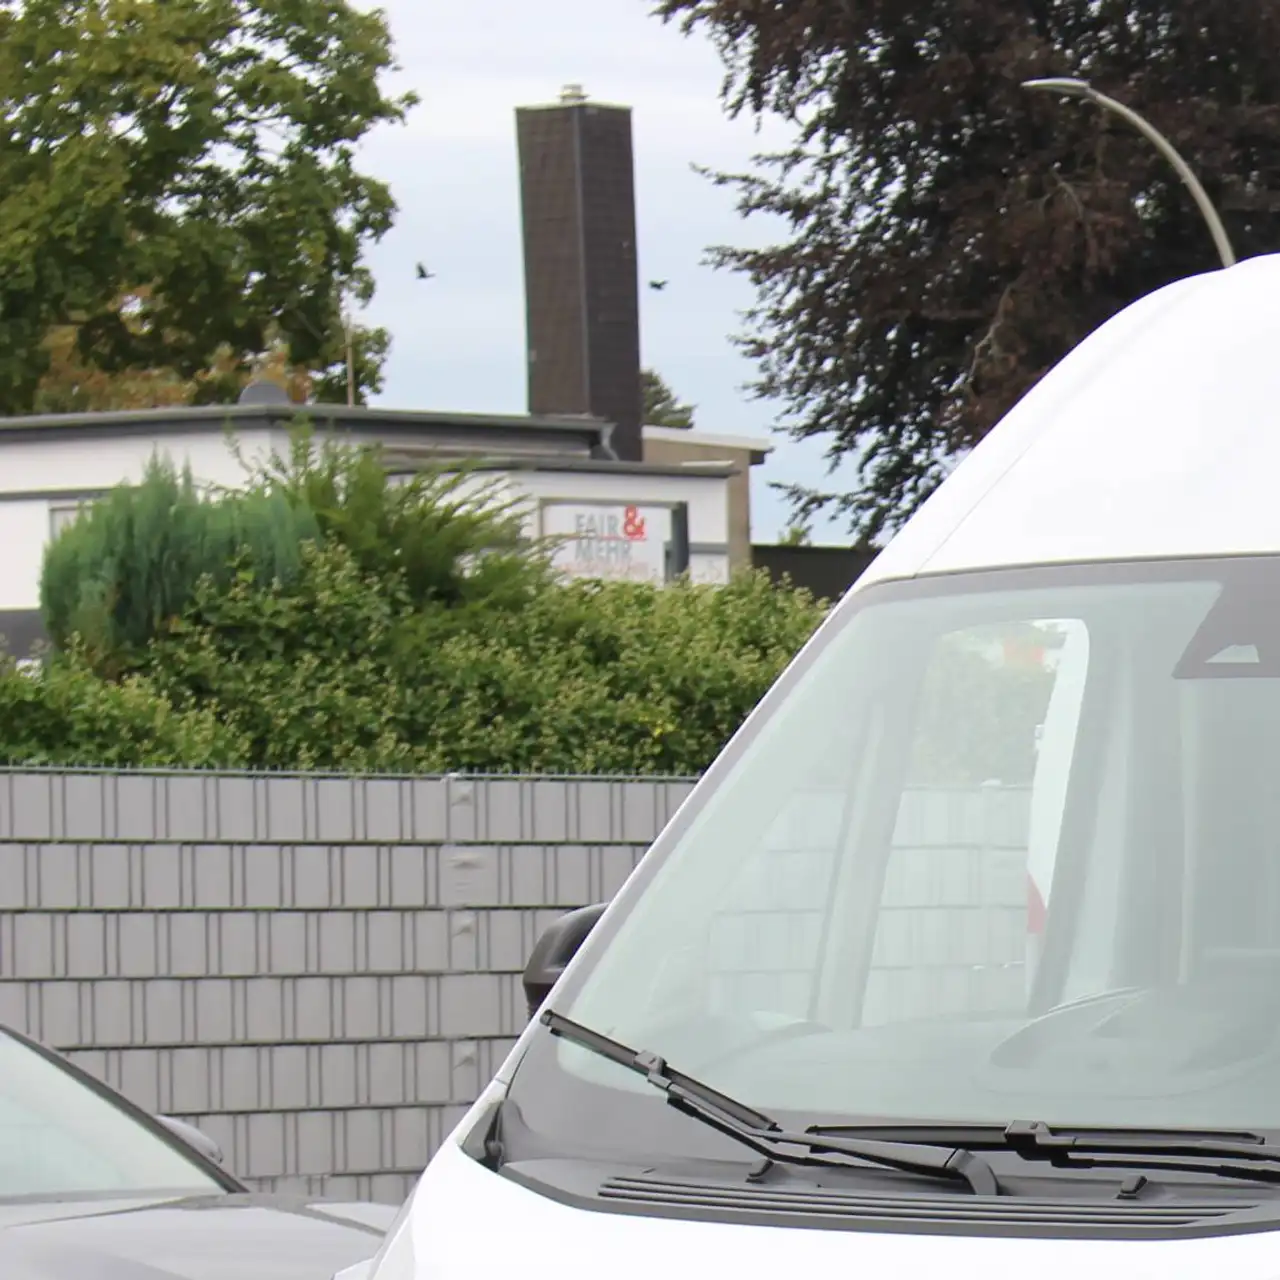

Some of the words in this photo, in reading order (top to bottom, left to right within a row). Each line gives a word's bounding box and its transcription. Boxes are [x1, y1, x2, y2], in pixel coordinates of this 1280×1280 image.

[575, 513, 620, 539] FAIR
[623, 504, 646, 537] &
[574, 539, 634, 564] MEHR
